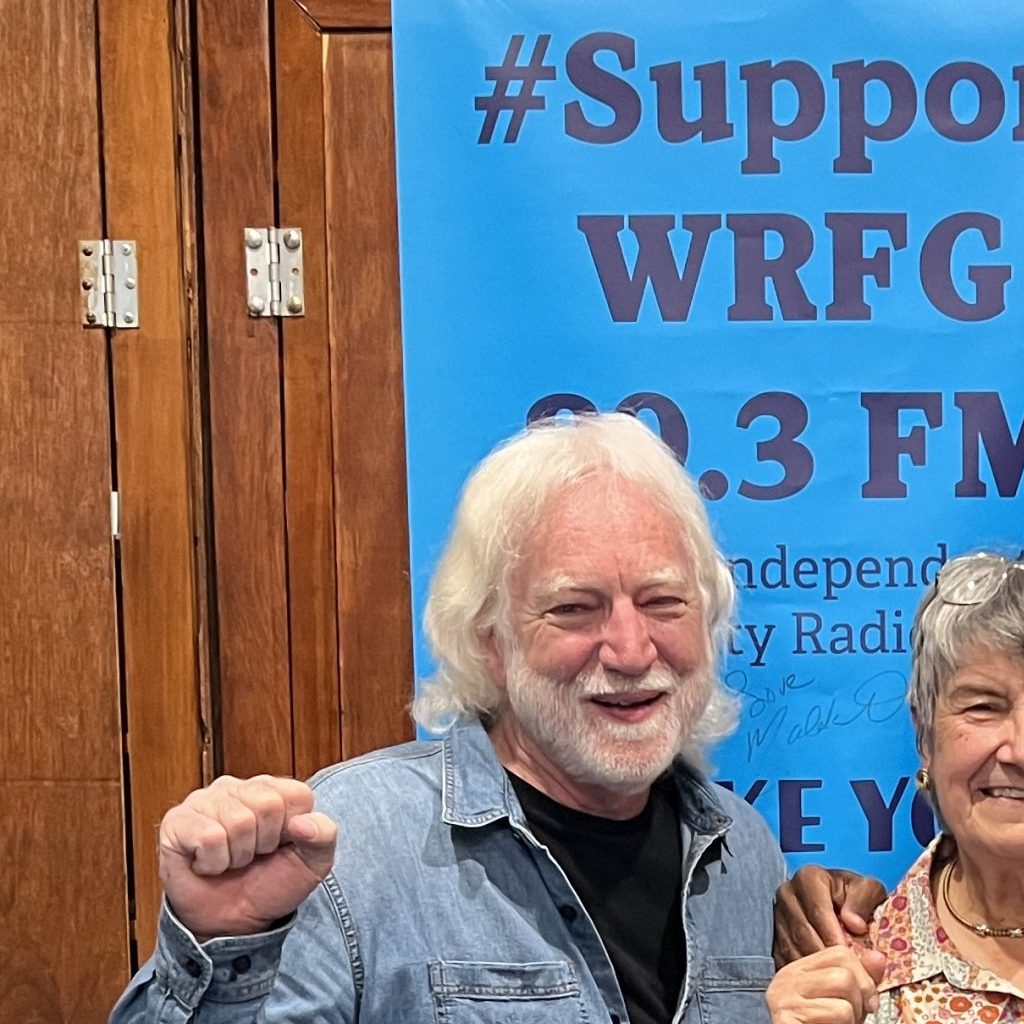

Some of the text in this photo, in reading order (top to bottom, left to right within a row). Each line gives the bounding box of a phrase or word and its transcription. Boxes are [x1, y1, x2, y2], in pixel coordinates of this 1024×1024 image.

[577, 212, 1012, 322] WRFG
[728, 543, 947, 601] ndepend
[791, 609, 914, 655] Radi
